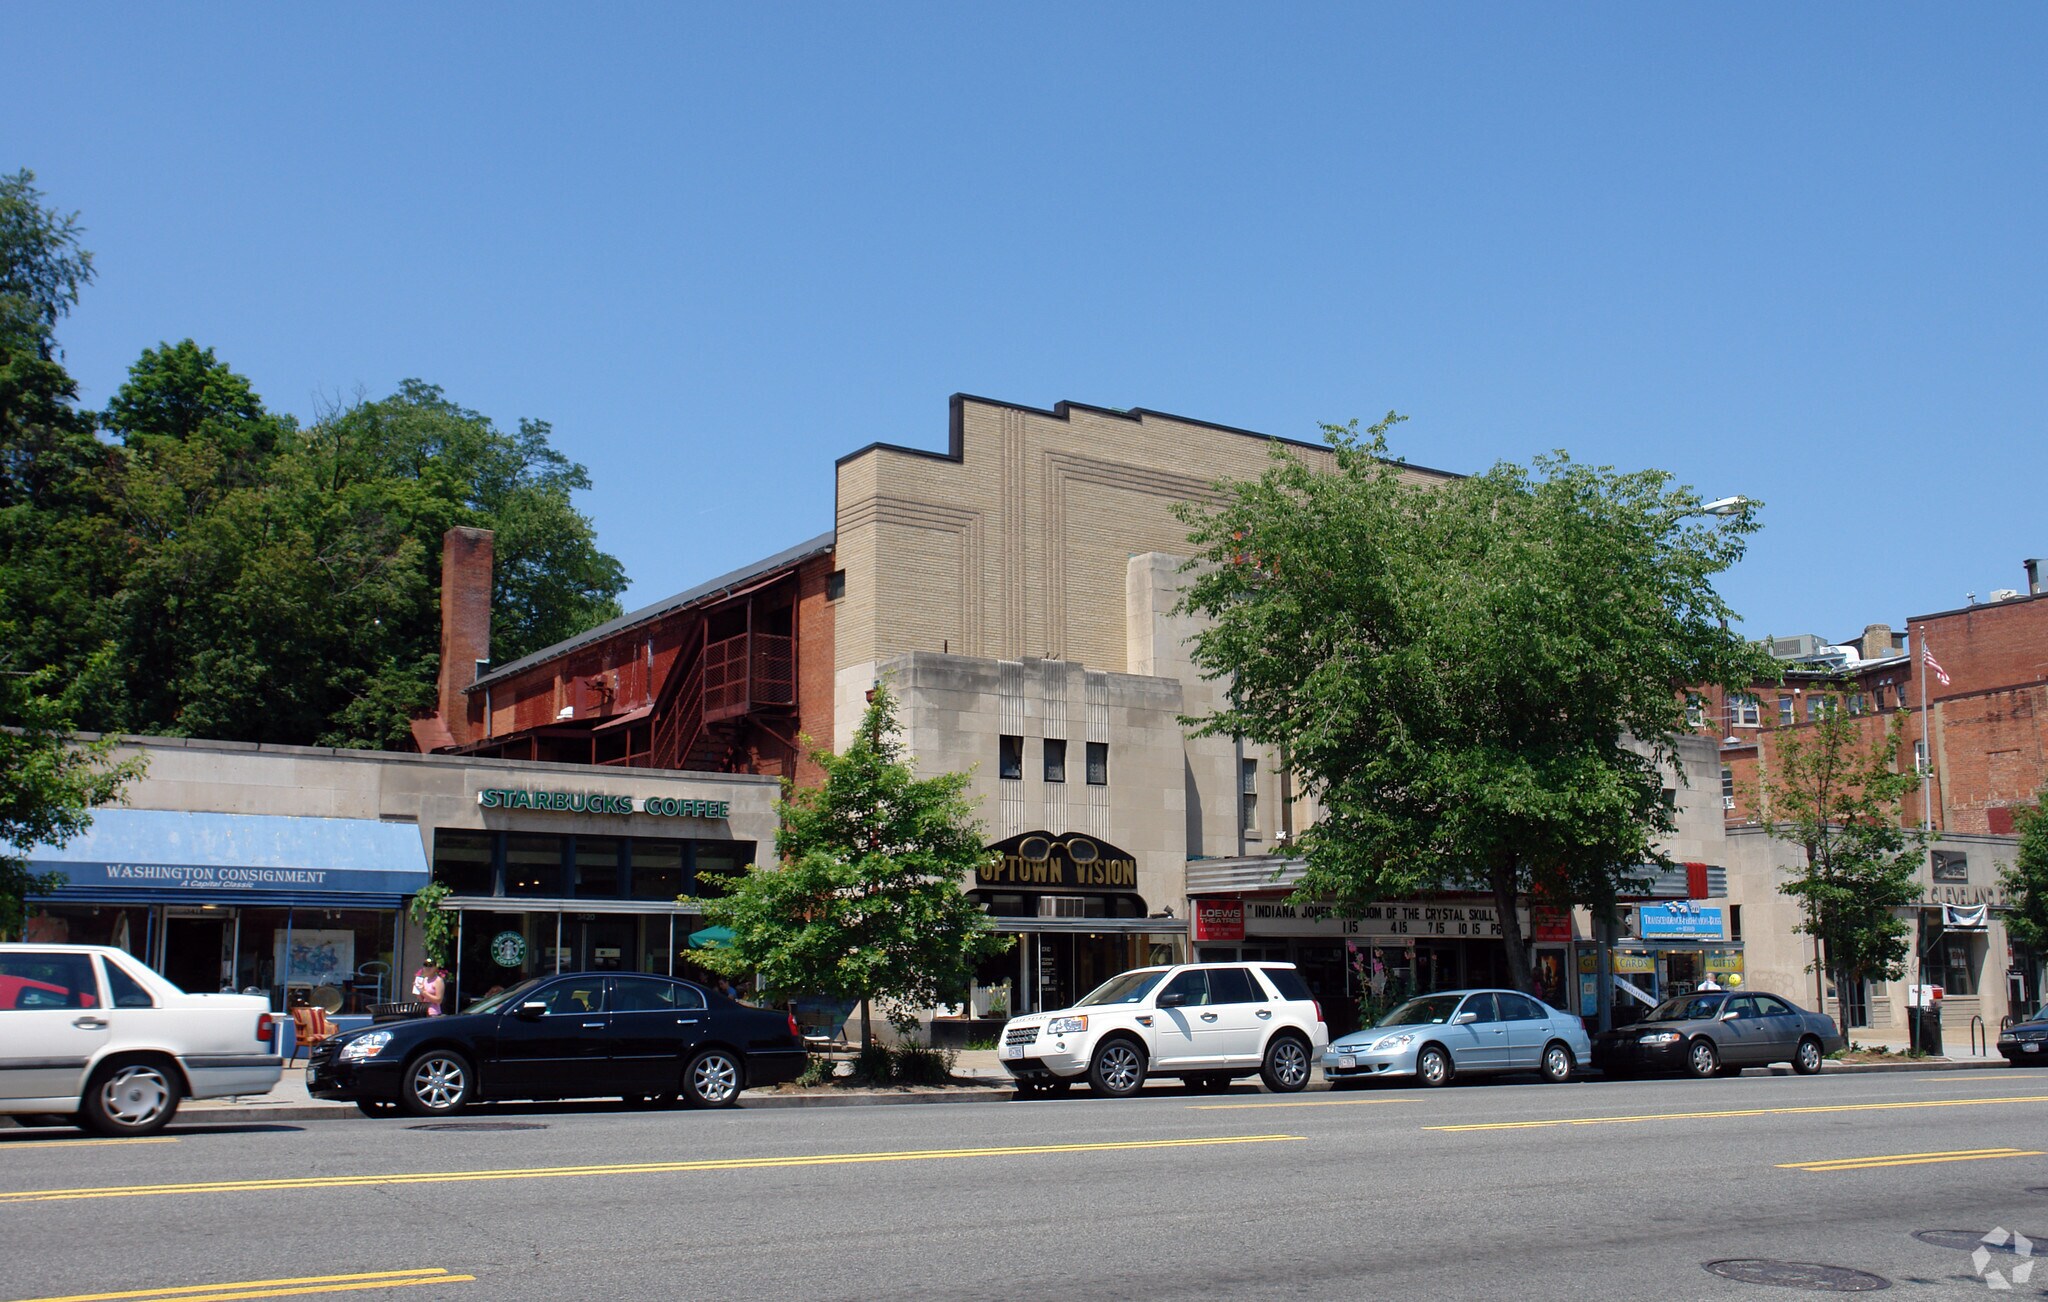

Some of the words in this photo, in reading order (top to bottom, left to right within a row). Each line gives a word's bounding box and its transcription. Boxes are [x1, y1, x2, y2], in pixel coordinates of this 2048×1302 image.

[481, 788, 634, 814] STARBUCKS
[644, 796, 730, 818] COFFEE
[106, 864, 214, 880] WASHINGTON
[218, 868, 326, 883] CONSIGNMENT
[980, 855, 1063, 883] UPTOWN
[1076, 859, 1135, 885] VISION
[190, 880, 221, 888] Capital
[222, 880, 254, 888] Classic
[1931, 886, 1994, 905] CLEVELAND
[1199, 909, 1241, 917] LOEWS
[1386, 907, 1397, 919] OF
[1403, 907, 1419, 920] THE
[1425, 908, 1465, 921] CRYSTAL
[492, 932, 525, 948] STARBUCKS
[496, 955, 521, 965] COFFEE
[1619, 958, 1648, 968] CARDS
[1712, 958, 1736, 968] GIFTS
